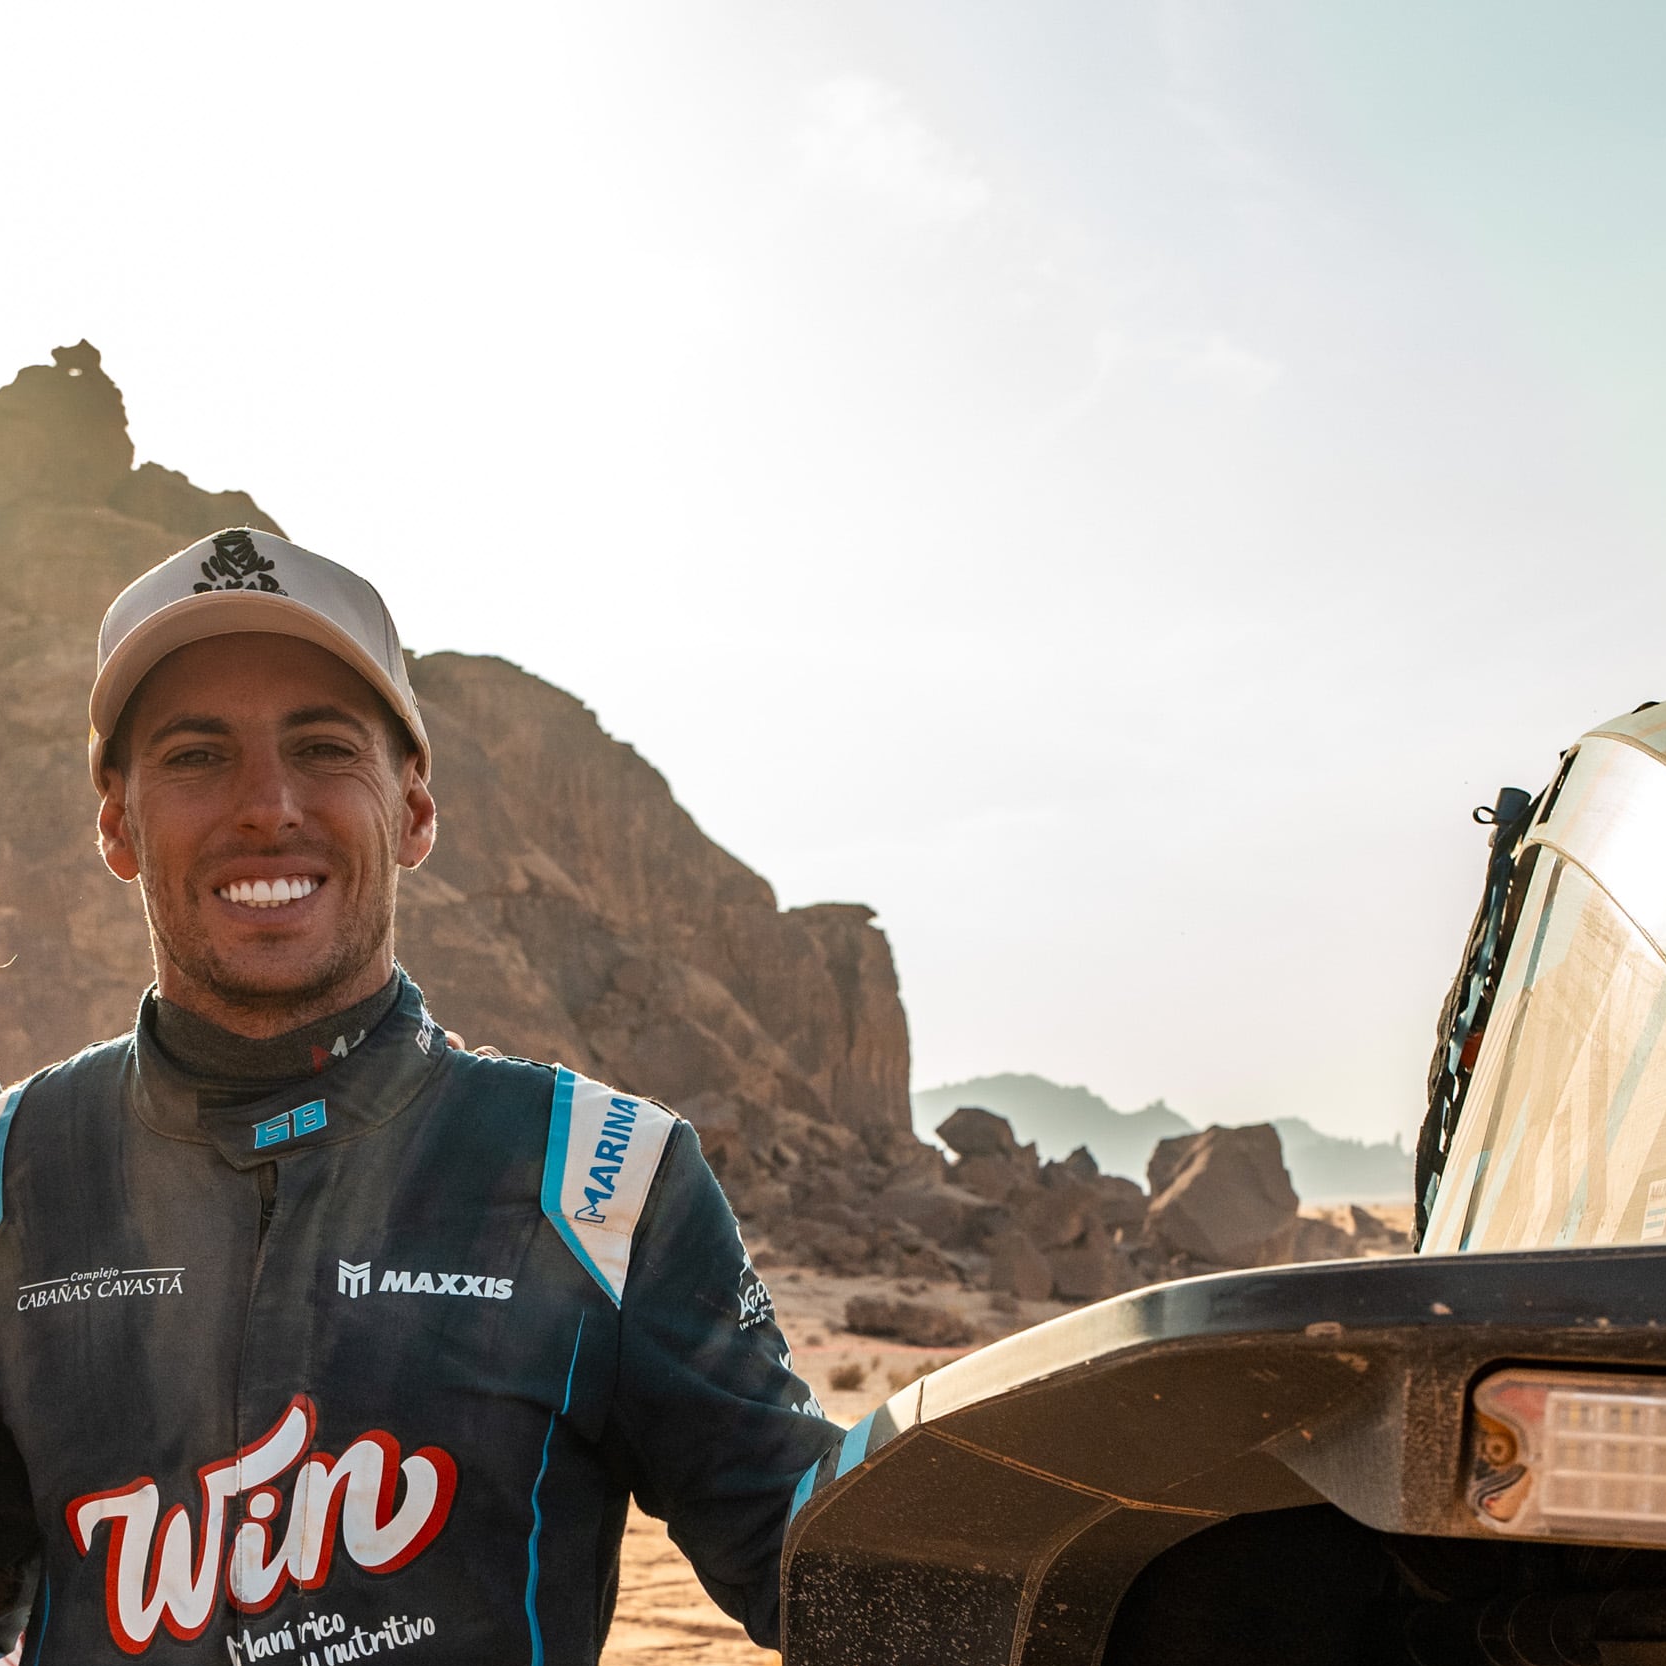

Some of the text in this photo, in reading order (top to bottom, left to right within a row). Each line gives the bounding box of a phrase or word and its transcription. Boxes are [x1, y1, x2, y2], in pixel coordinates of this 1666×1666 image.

[252, 1098, 327, 1149] 68
[574, 1097, 640, 1223] MARINA
[16, 1272, 184, 1312] CABAÑAS CAYASTÁ
[70, 1267, 119, 1282] Complejo
[378, 1270, 514, 1300] MAXXIS
[66, 1393, 458, 1655] Win
[297, 1611, 346, 1644] rico
[324, 1615, 436, 1666] nutritivo
